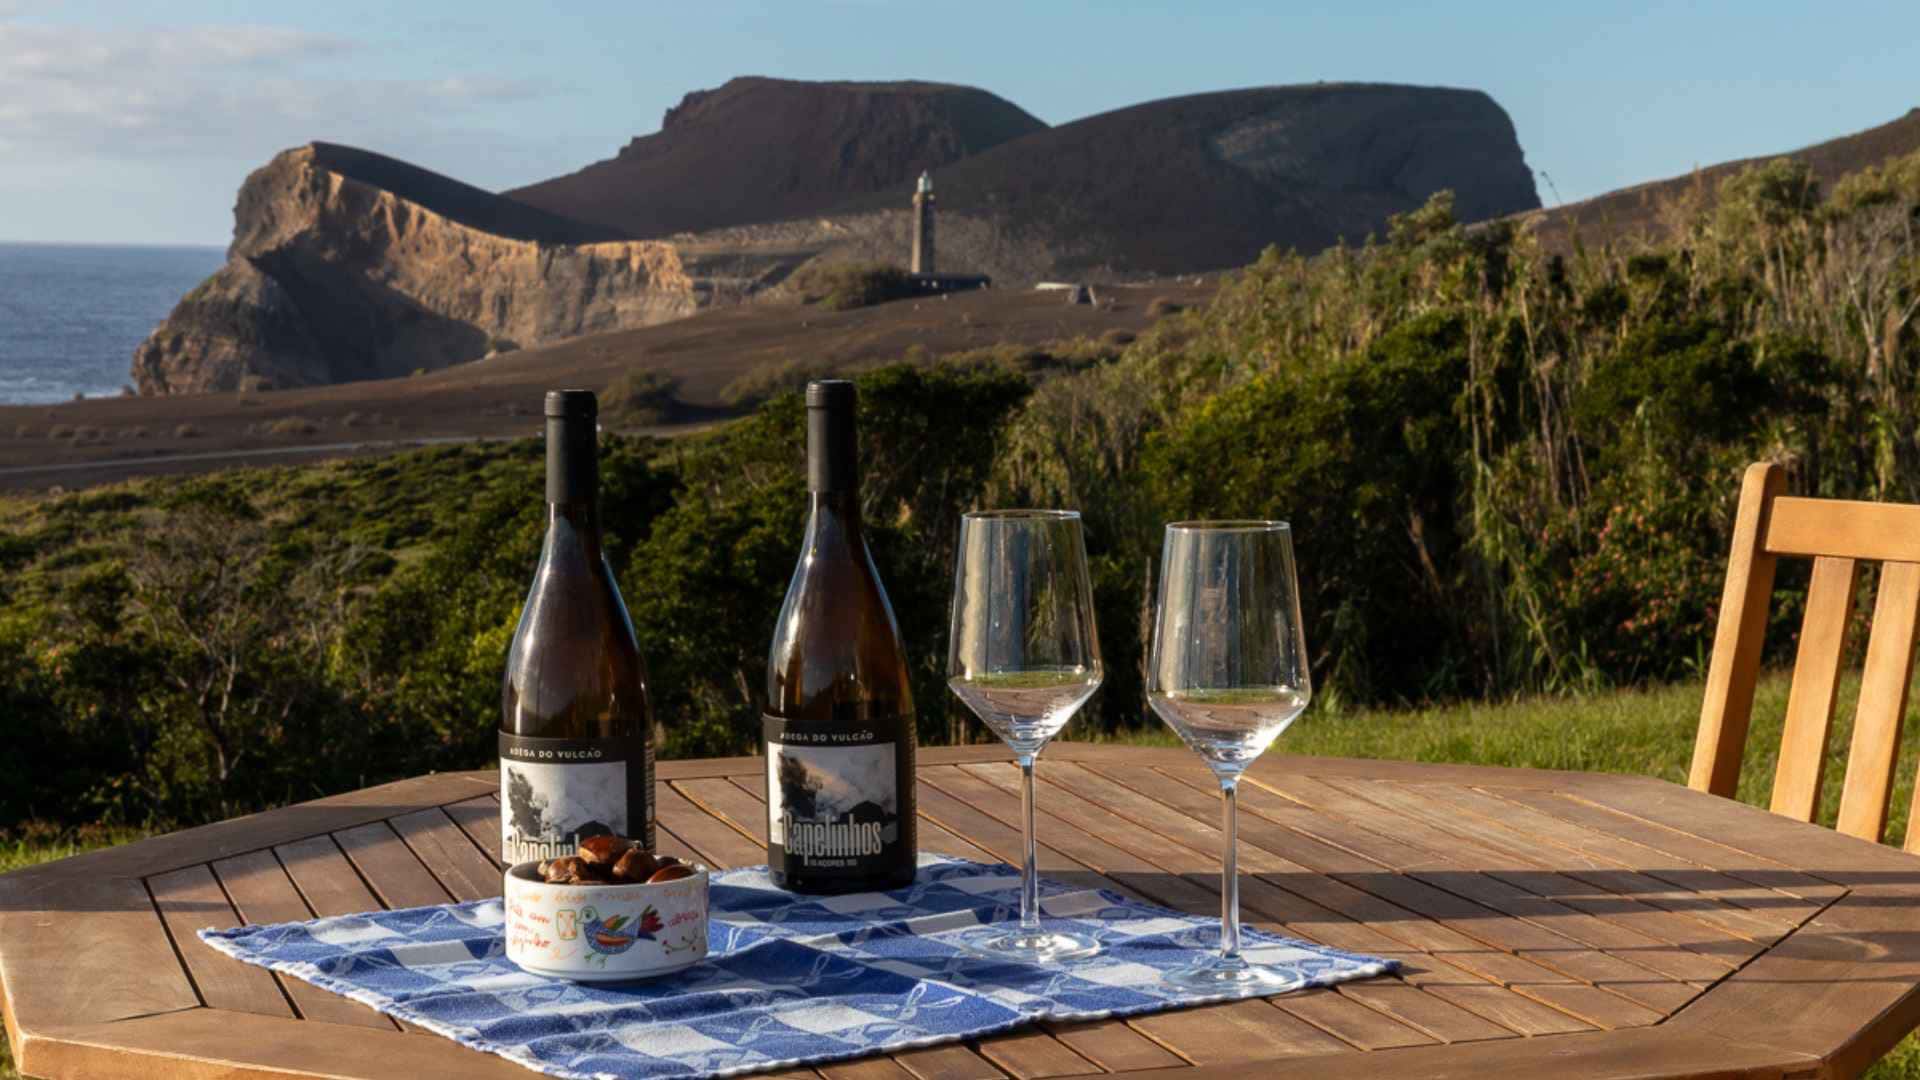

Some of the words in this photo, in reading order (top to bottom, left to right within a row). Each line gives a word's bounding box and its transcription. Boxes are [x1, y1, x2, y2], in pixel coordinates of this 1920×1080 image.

[812, 734, 827, 742] DO
[831, 730, 873, 741] VULCÃO
[538, 750, 553, 758] DO
[557, 747, 602, 758] VULCÃO
[511, 829, 580, 866] Capeli
[783, 810, 883, 867] Capelinhos
